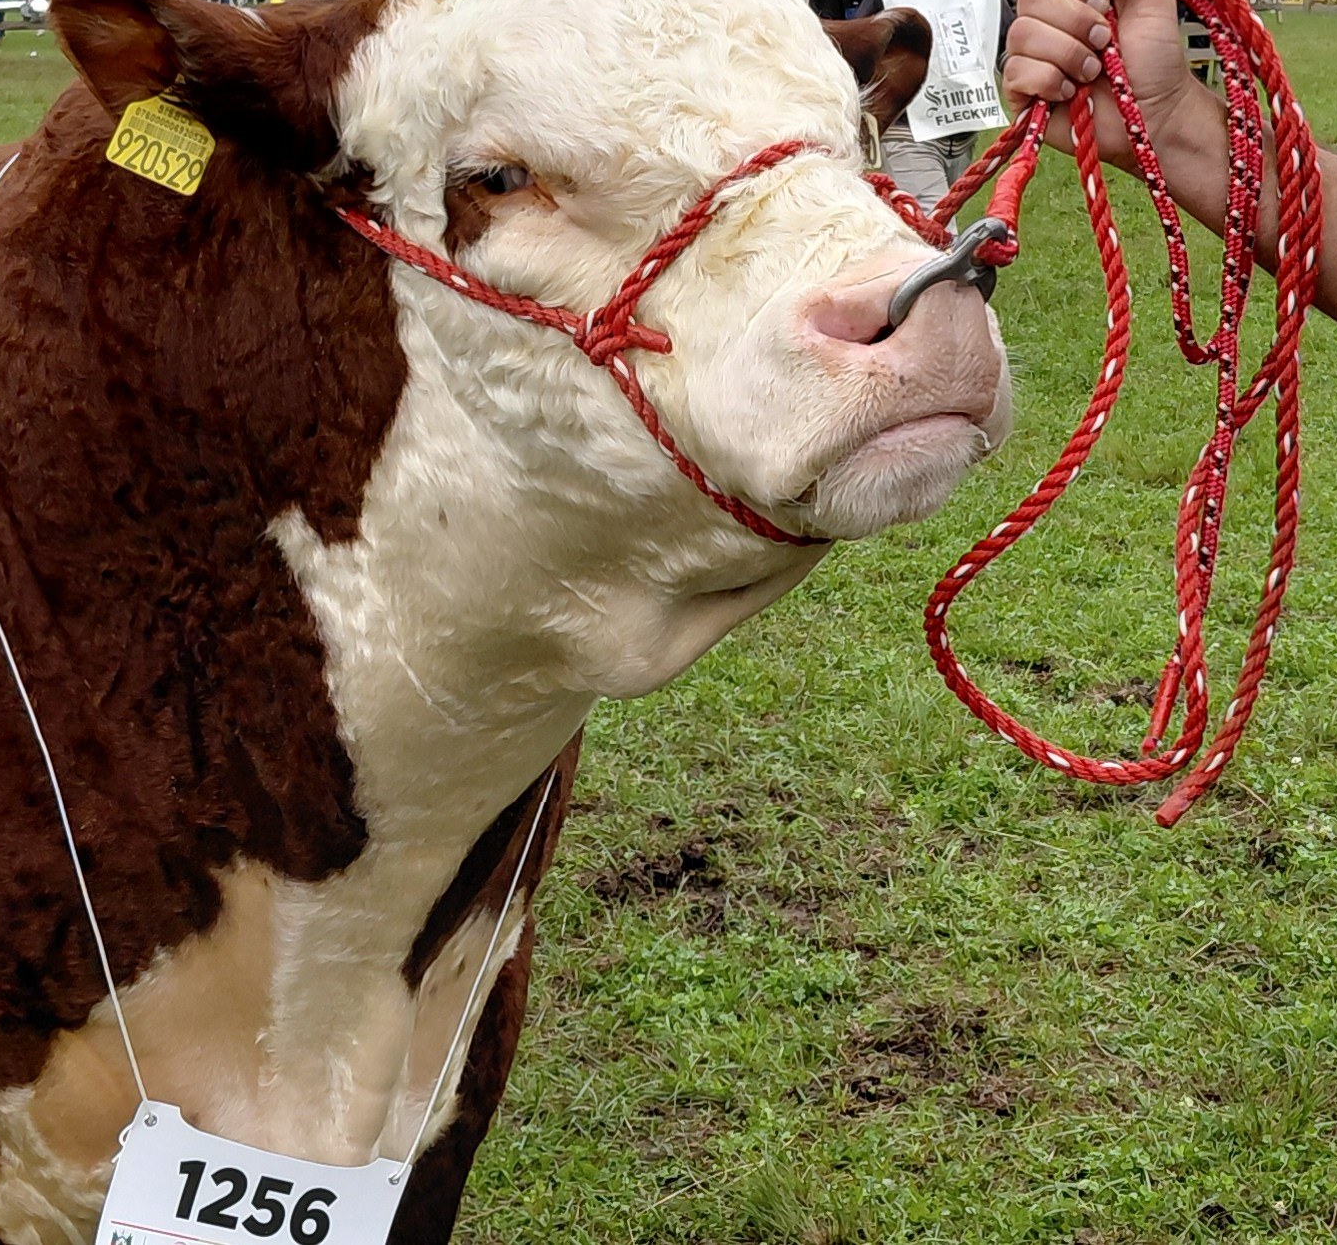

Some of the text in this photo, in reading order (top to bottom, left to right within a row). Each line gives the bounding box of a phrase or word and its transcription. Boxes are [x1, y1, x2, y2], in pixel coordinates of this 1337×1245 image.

[951, 20, 971, 57] 1774
[935, 106, 1000, 126] FLECKVIE
[111, 128, 204, 191] 920529
[175, 1160, 339, 1245] 1256
